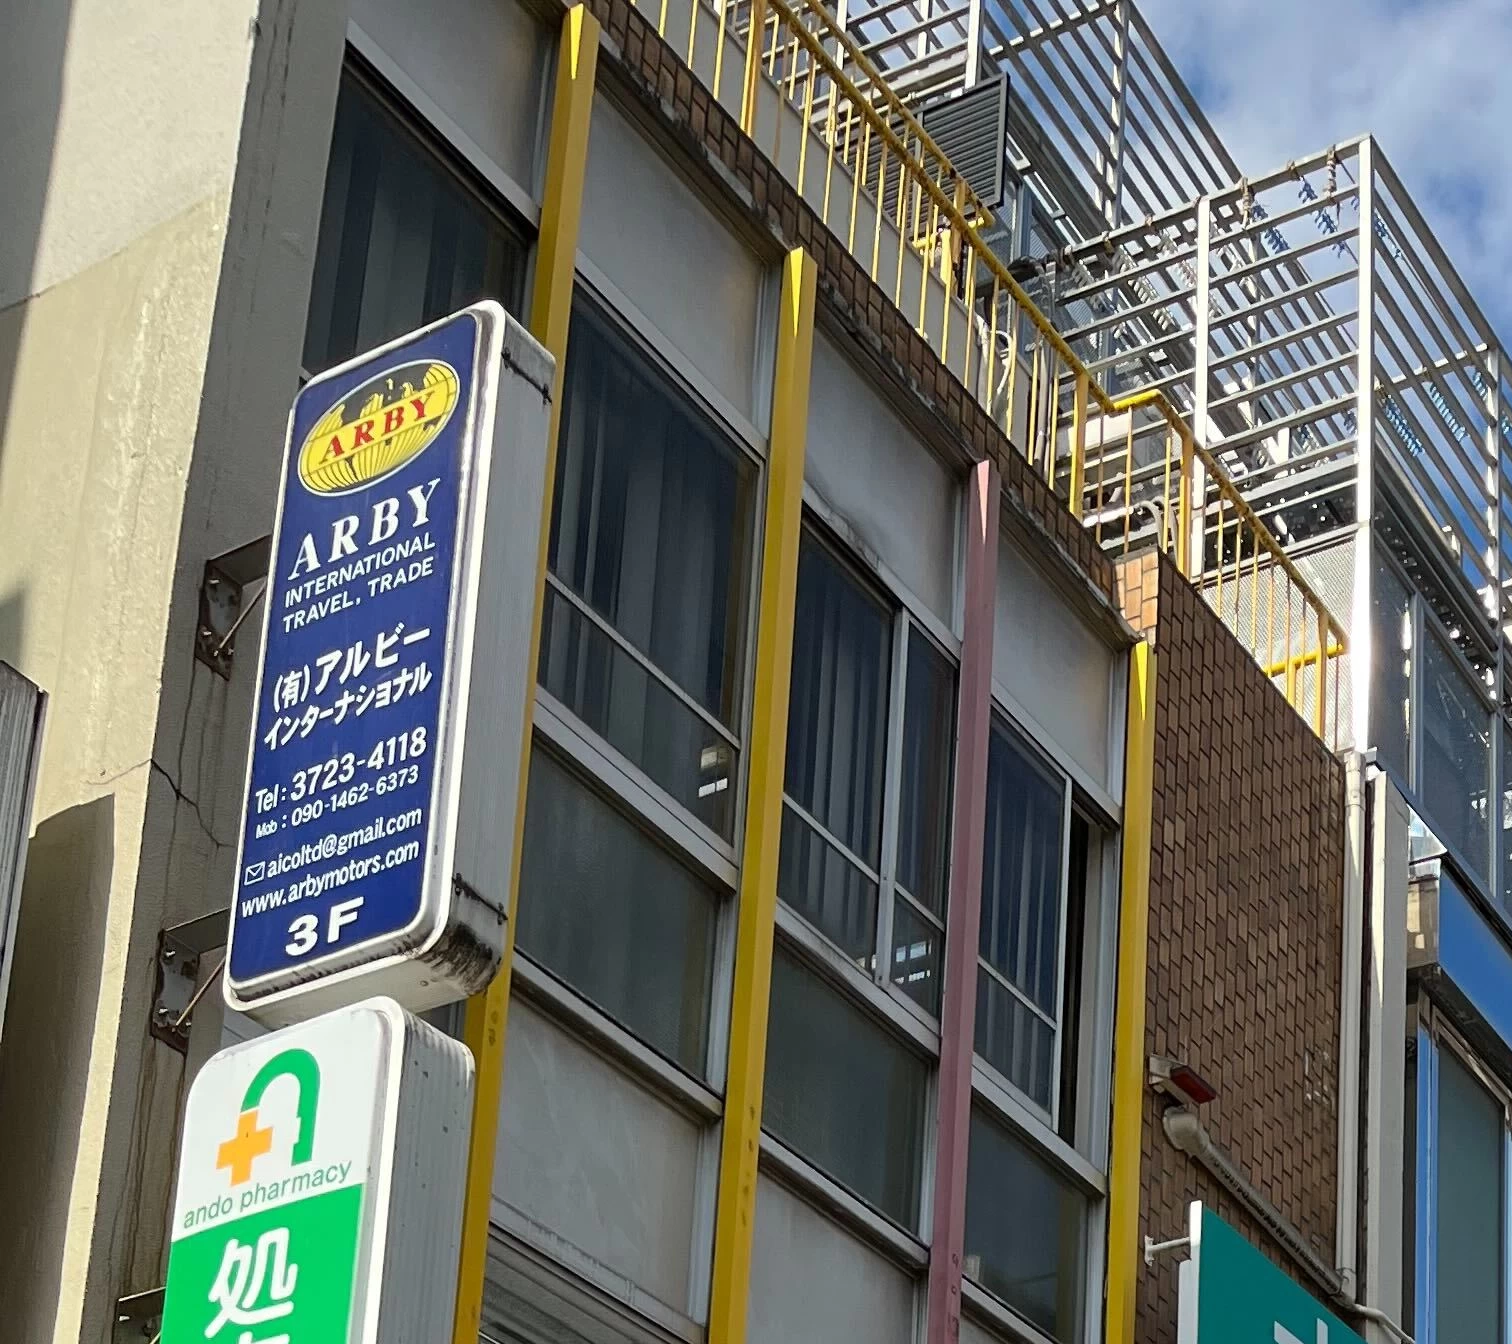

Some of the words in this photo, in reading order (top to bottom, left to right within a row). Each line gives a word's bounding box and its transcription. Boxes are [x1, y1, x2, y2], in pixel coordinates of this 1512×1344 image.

[320, 390, 436, 462] ARBY
[287, 478, 440, 580] ARBY
[285, 534, 435, 608] INTERNATIONAL
[368, 556, 434, 598] TRADE
[263, 659, 432, 753] インターナショナル
[291, 726, 427, 802] 3723-4118
[291, 764, 420, 827] 090-1462-6373
[242, 838, 420, 918] www.arbymotors.com
[268, 807, 422, 878] aicoltd@gmail.com
[285, 897, 365, 956] 3F
[184, 1196, 233, 1229] ando
[240, 1160, 352, 1213] pharmacy
